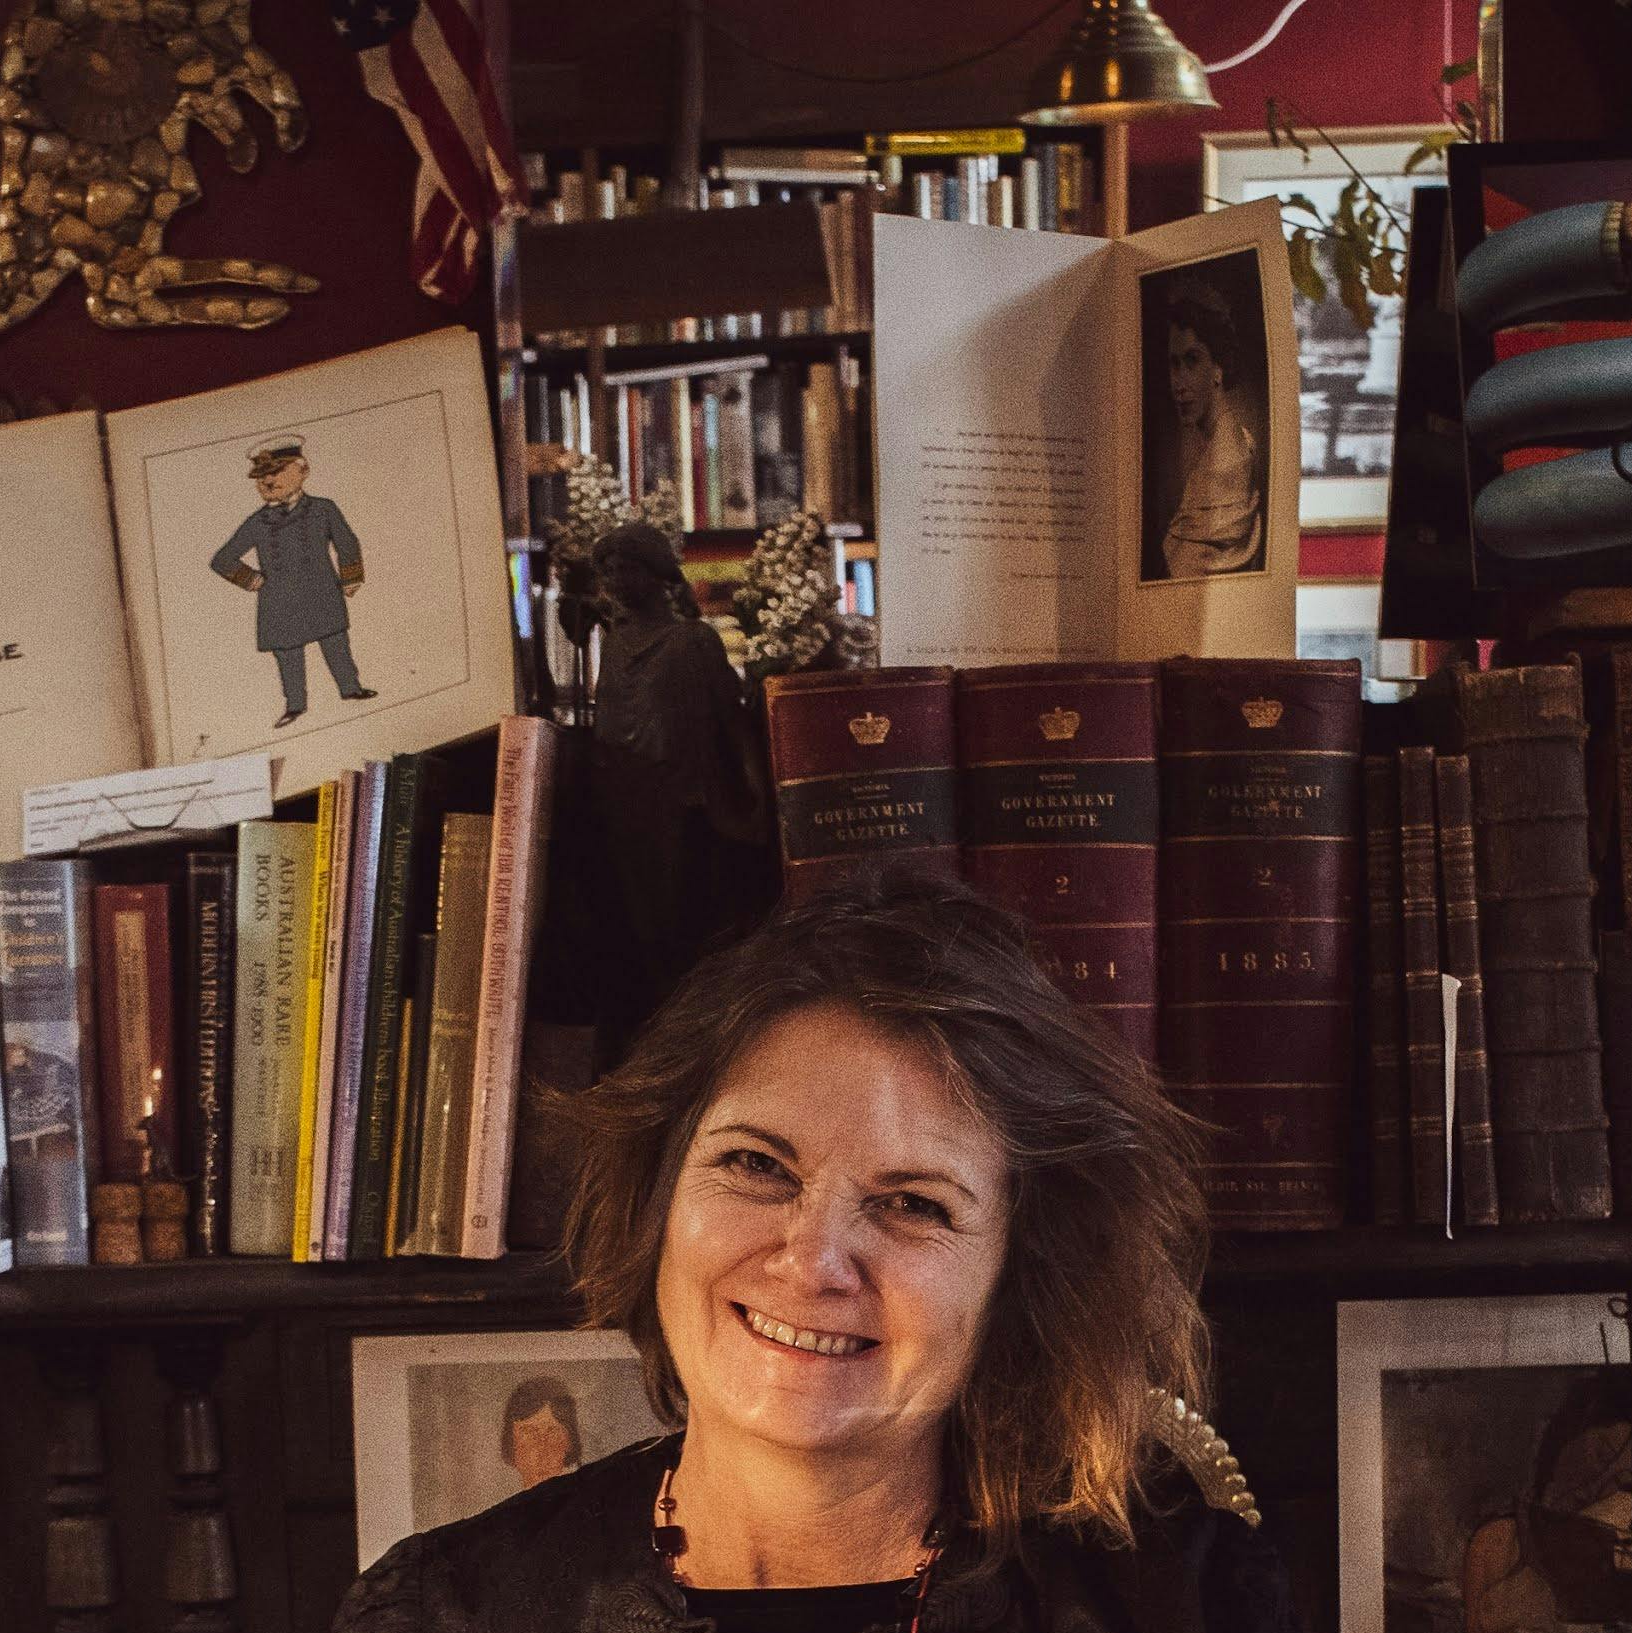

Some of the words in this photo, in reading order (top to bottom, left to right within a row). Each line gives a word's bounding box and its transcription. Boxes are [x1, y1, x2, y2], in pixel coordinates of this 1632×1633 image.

[1001, 793, 1117, 811] GOVERNMENT
[1207, 784, 1324, 799] GOVERNMENT
[814, 801, 926, 826] GOVERNMENT
[254, 853, 272, 922] BOOKS
[275, 855, 297, 988] AUSTRALIAN
[273, 995, 293, 1047] RARE
